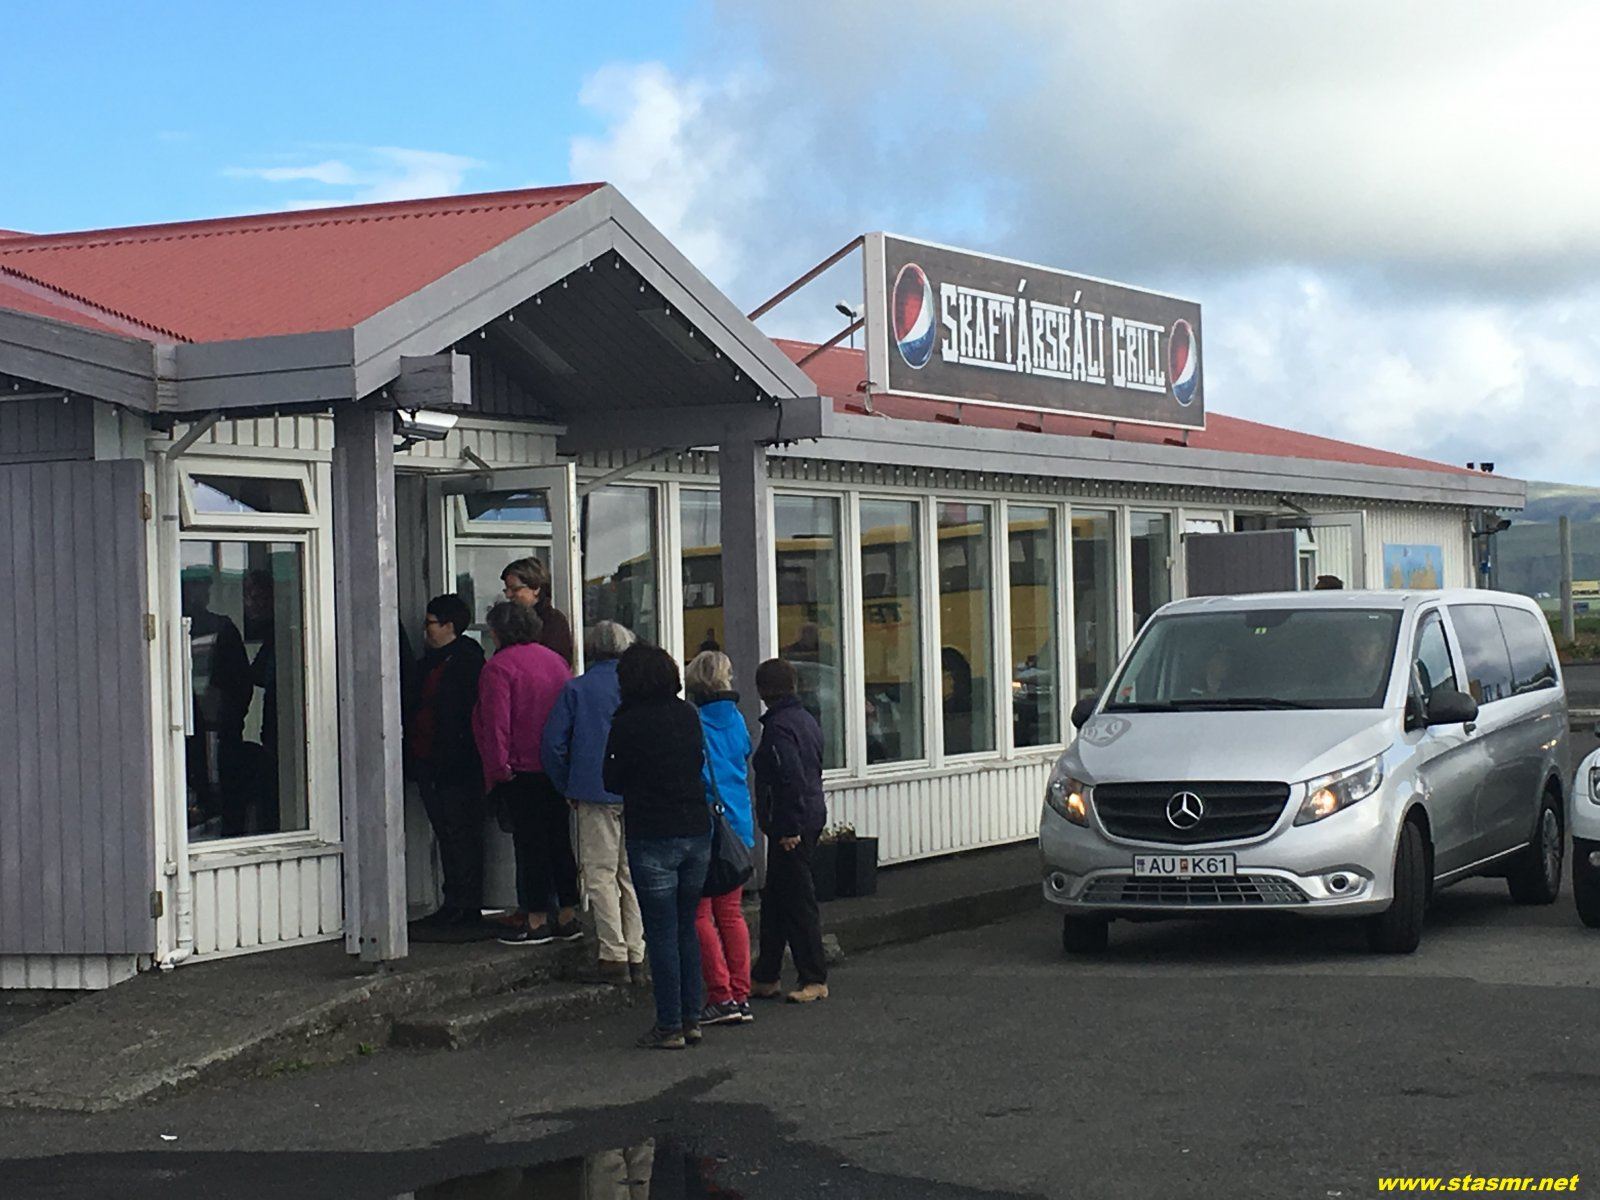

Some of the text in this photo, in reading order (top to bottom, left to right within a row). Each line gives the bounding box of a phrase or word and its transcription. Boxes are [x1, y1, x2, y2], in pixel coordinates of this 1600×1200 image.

[940, 278, 1167, 393] SKAFTÁRSKÁLI GRILL
[1149, 858, 1176, 874] AU
[1192, 858, 1227, 874] K61
